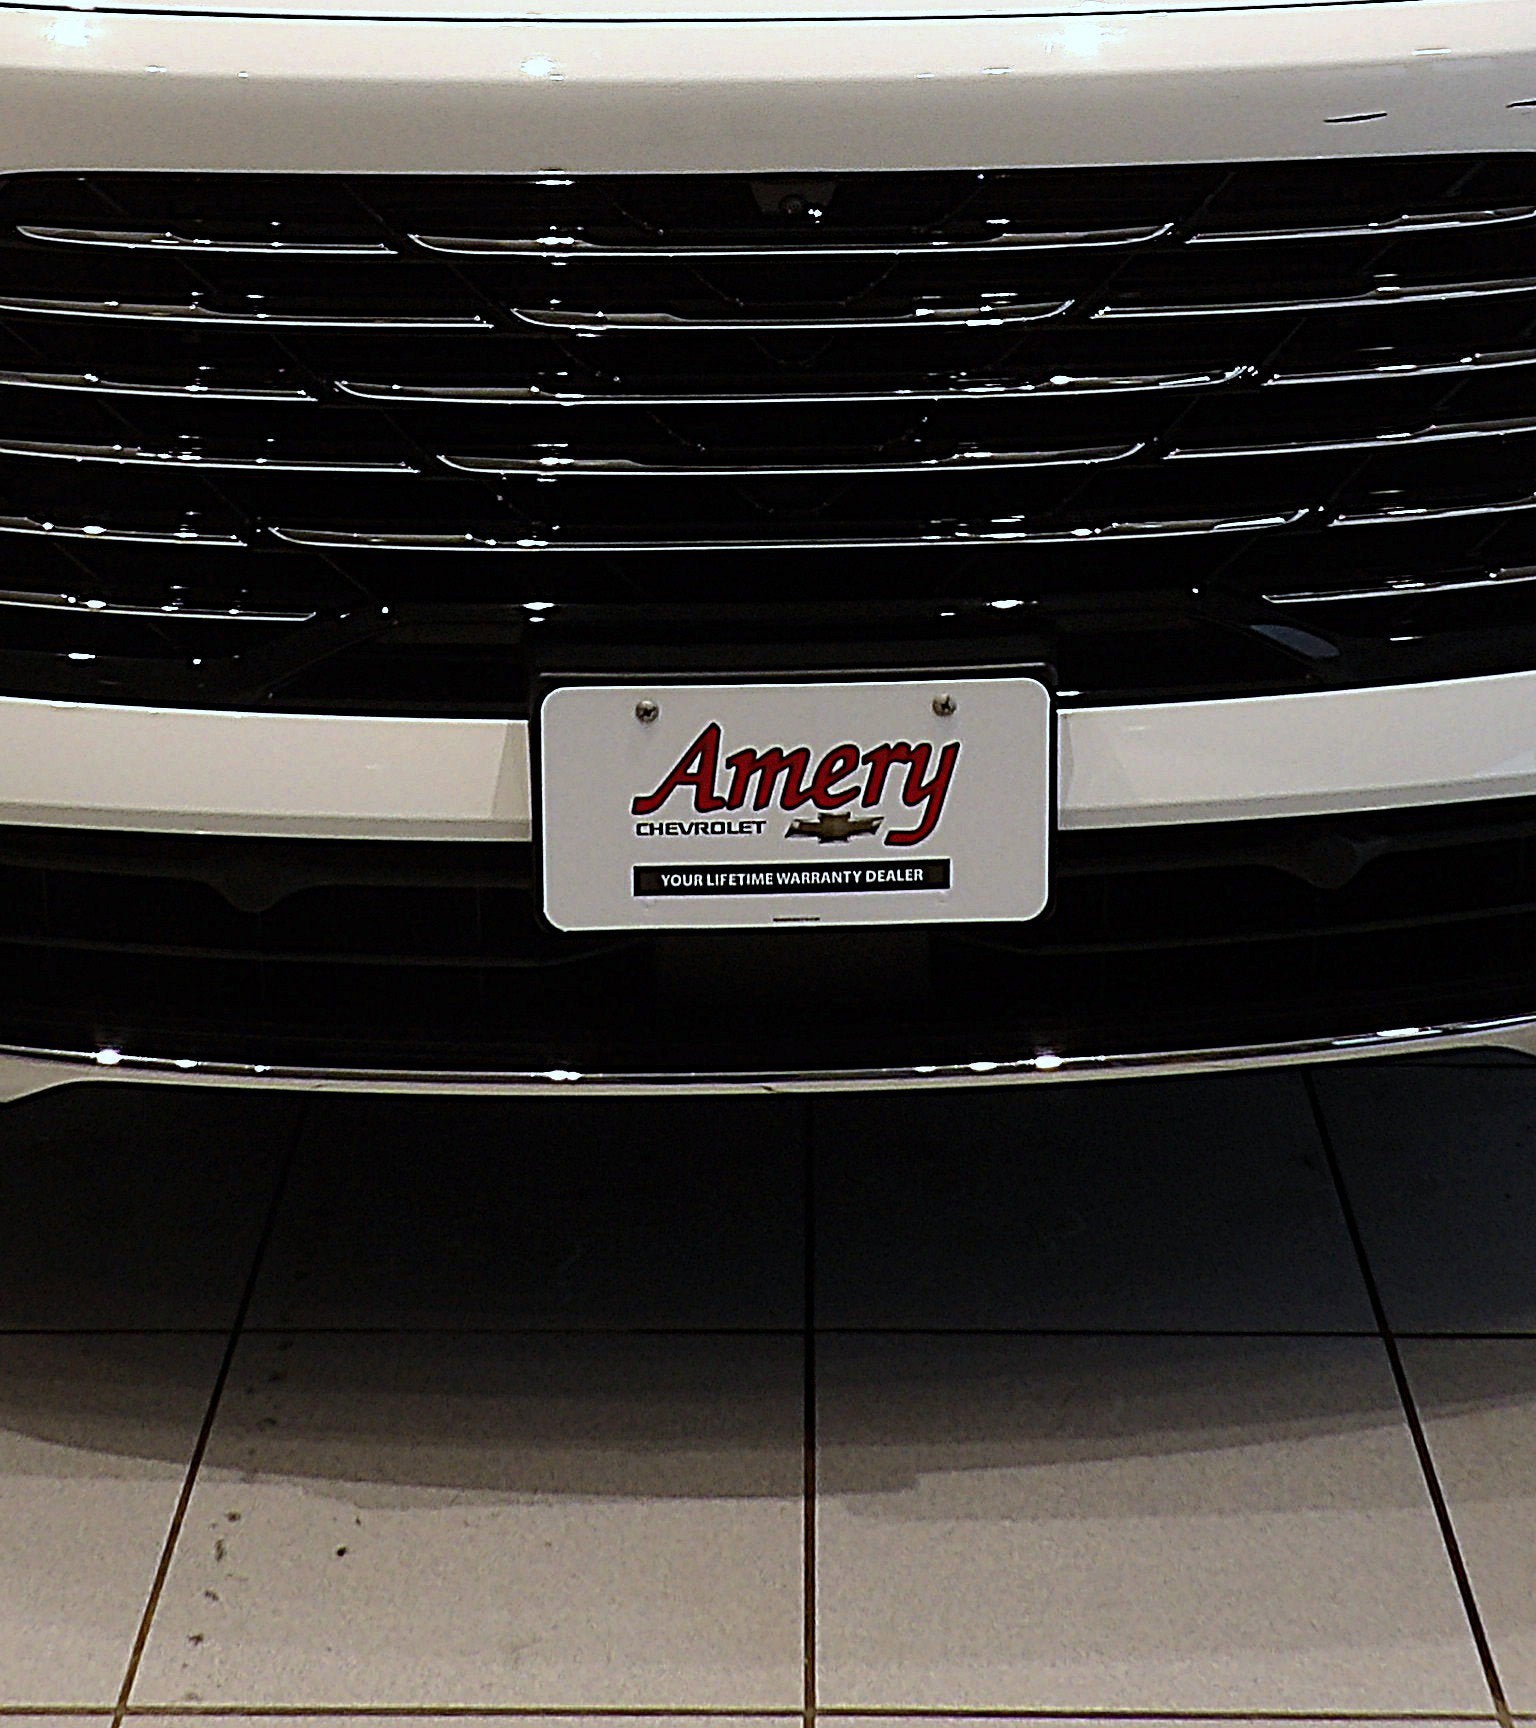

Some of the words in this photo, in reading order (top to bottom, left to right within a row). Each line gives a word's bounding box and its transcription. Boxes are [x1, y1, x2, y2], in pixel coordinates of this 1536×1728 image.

[631, 721, 961, 847] Amery
[635, 820, 767, 837] CHEVROLET
[661, 873, 703, 888] YOUR
[706, 872, 774, 887] LIFETIME
[776, 870, 863, 885] WARRANTY
[865, 868, 924, 883] DEALER
